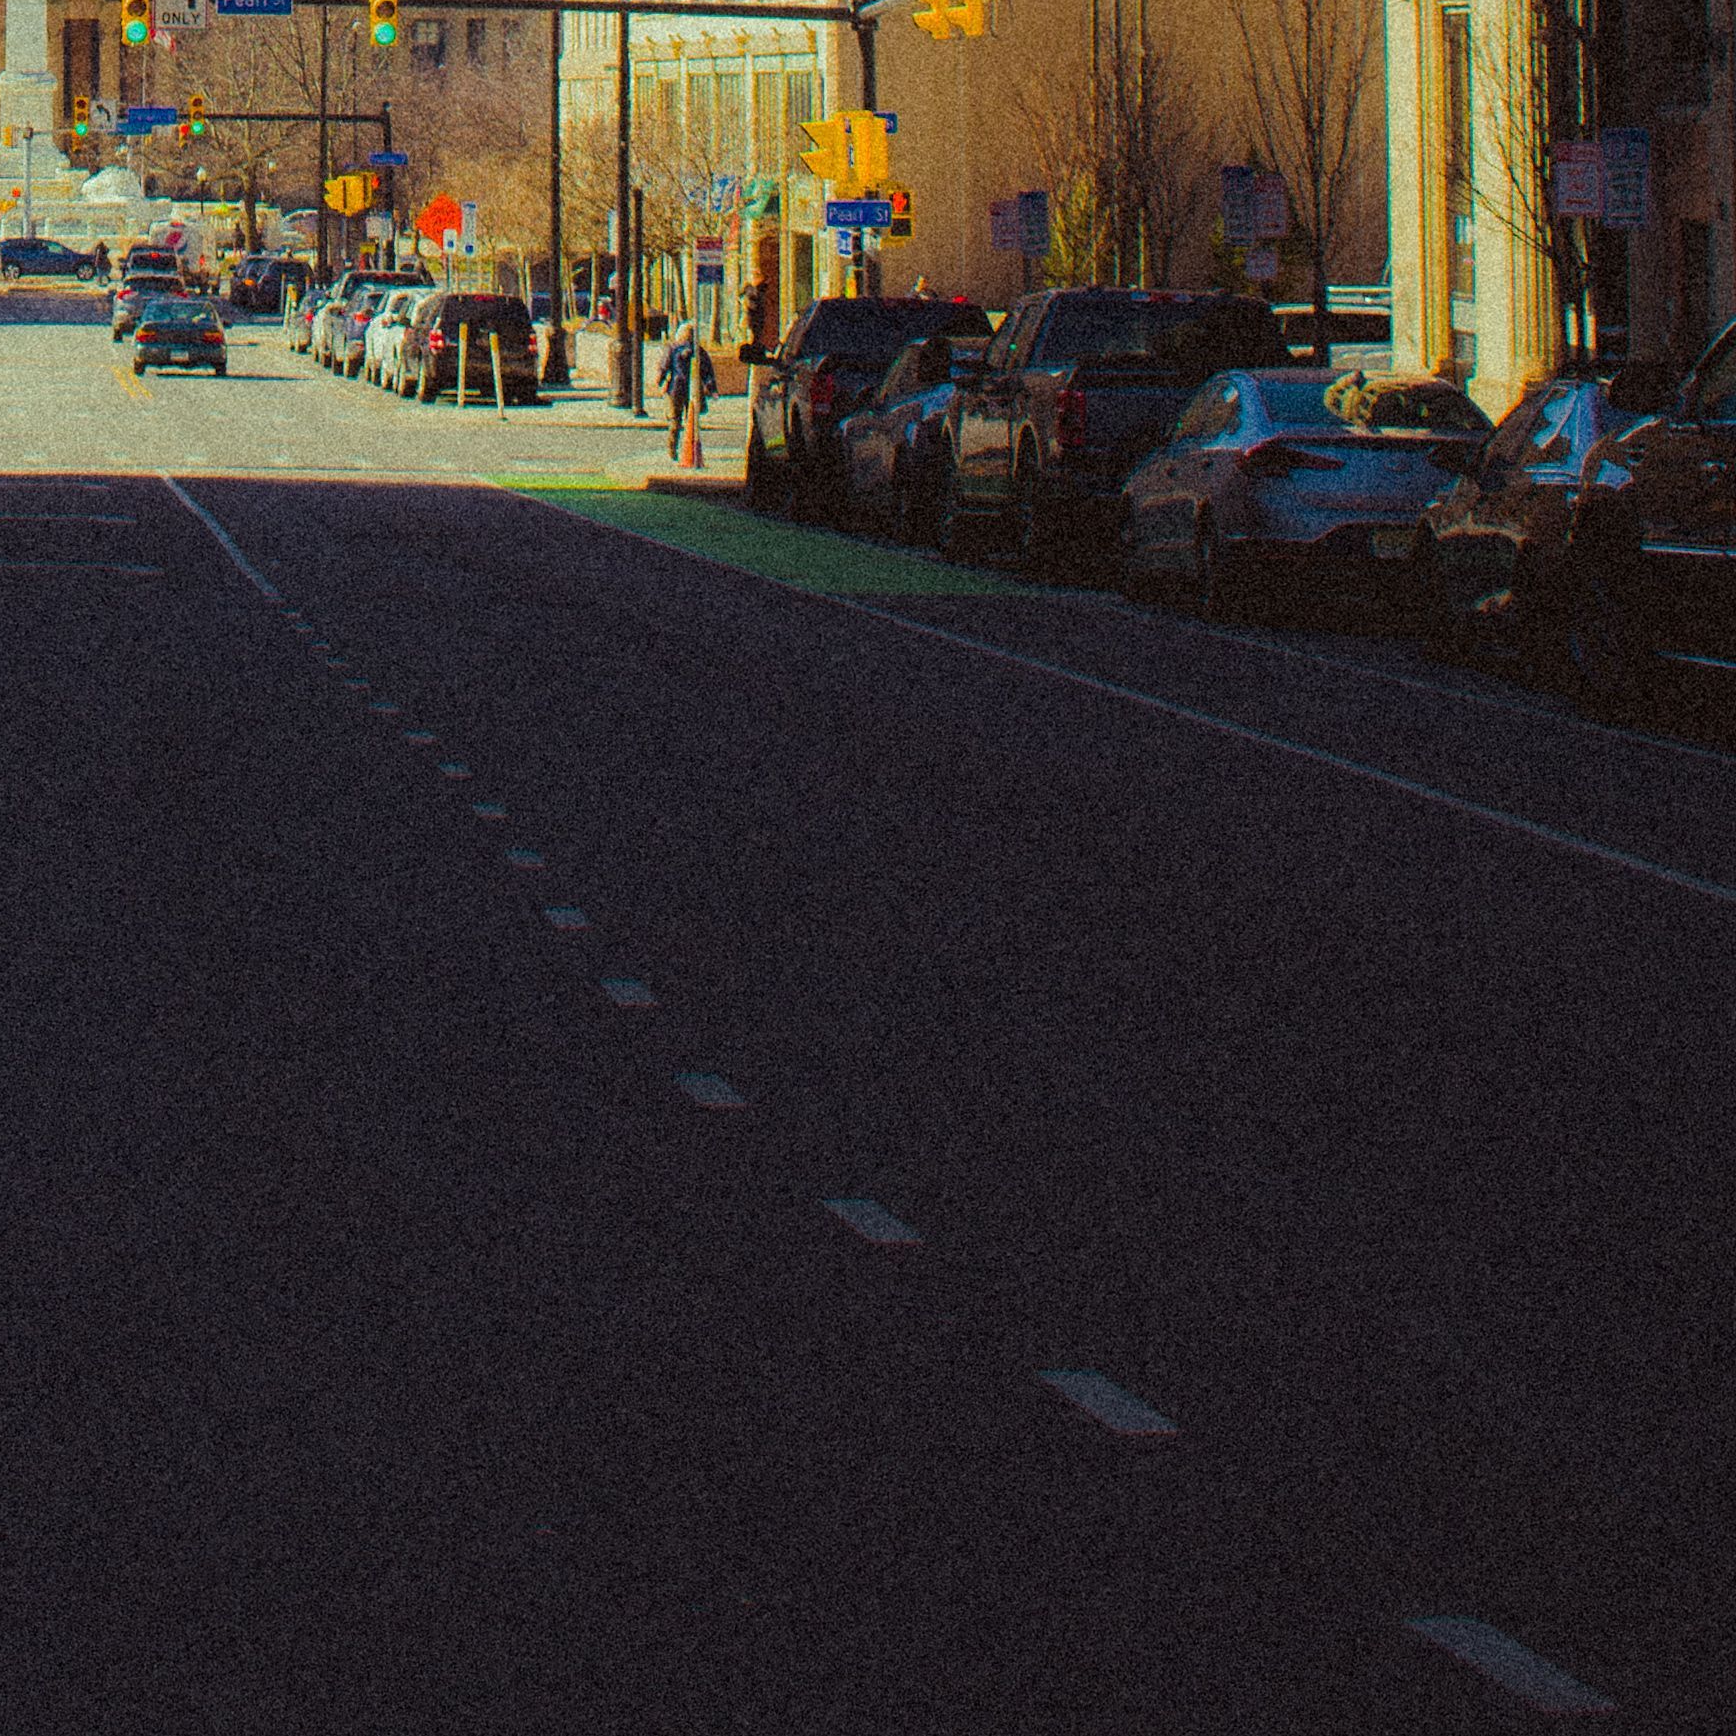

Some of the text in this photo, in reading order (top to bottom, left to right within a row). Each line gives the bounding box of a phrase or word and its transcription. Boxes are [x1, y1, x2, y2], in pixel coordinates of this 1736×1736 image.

[161, 11, 201, 25] ONLY
[829, 207, 889, 222] Pearl St
